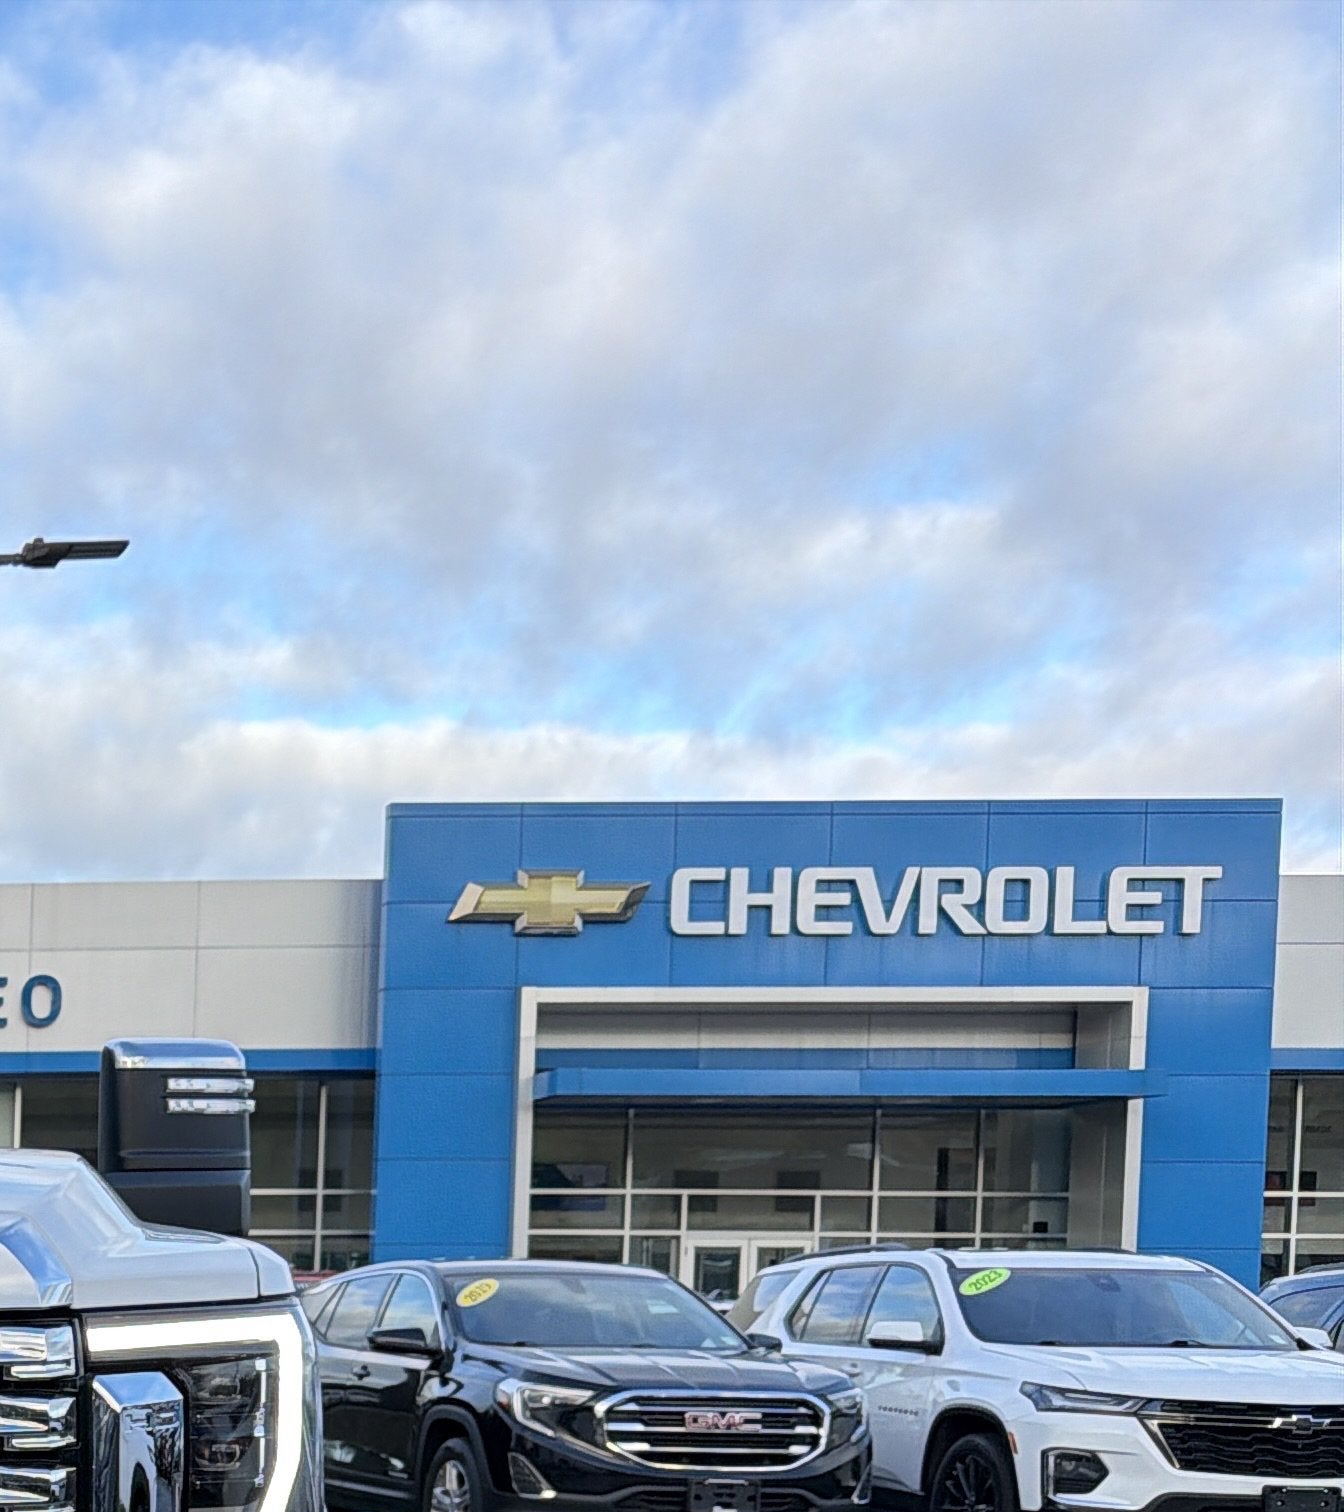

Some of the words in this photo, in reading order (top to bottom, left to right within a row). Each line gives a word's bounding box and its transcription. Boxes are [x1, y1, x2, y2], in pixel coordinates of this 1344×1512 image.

[670, 866, 1223, 936] CHEVROLET
[968, 1269, 1003, 1292] 2023
[684, 1411, 762, 1433] GMC
